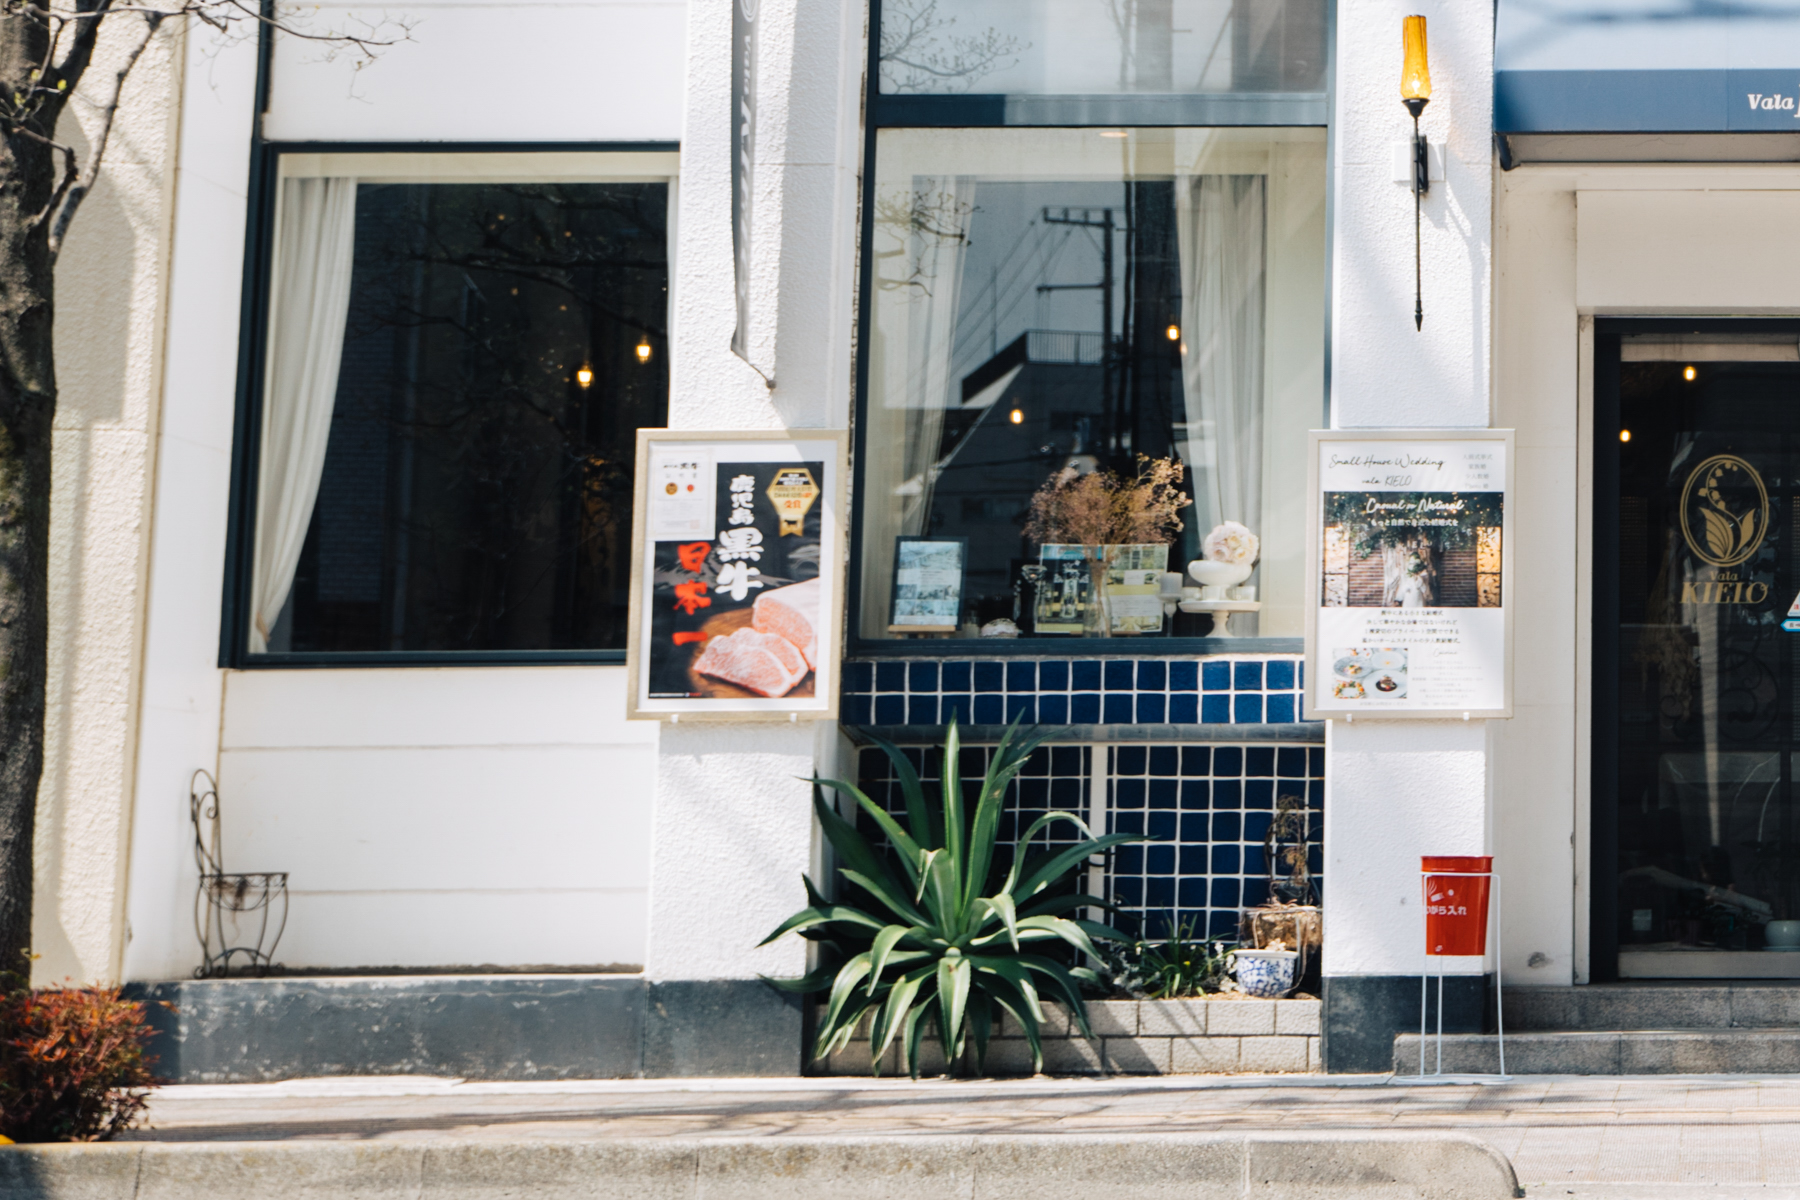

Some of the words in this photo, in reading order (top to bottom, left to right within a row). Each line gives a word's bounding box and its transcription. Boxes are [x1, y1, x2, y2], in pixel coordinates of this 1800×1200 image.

[1748, 94, 1794, 110] Vala
[1329, 453, 1361, 469] Small
[1395, 453, 1446, 471] Wedding
[1384, 475, 1412, 487] KIELO
[1417, 497, 1465, 513] Natural
[1710, 571, 1738, 581] Vala
[672, 541, 711, 646] 日本一
[1679, 581, 1769, 604] KIELO
